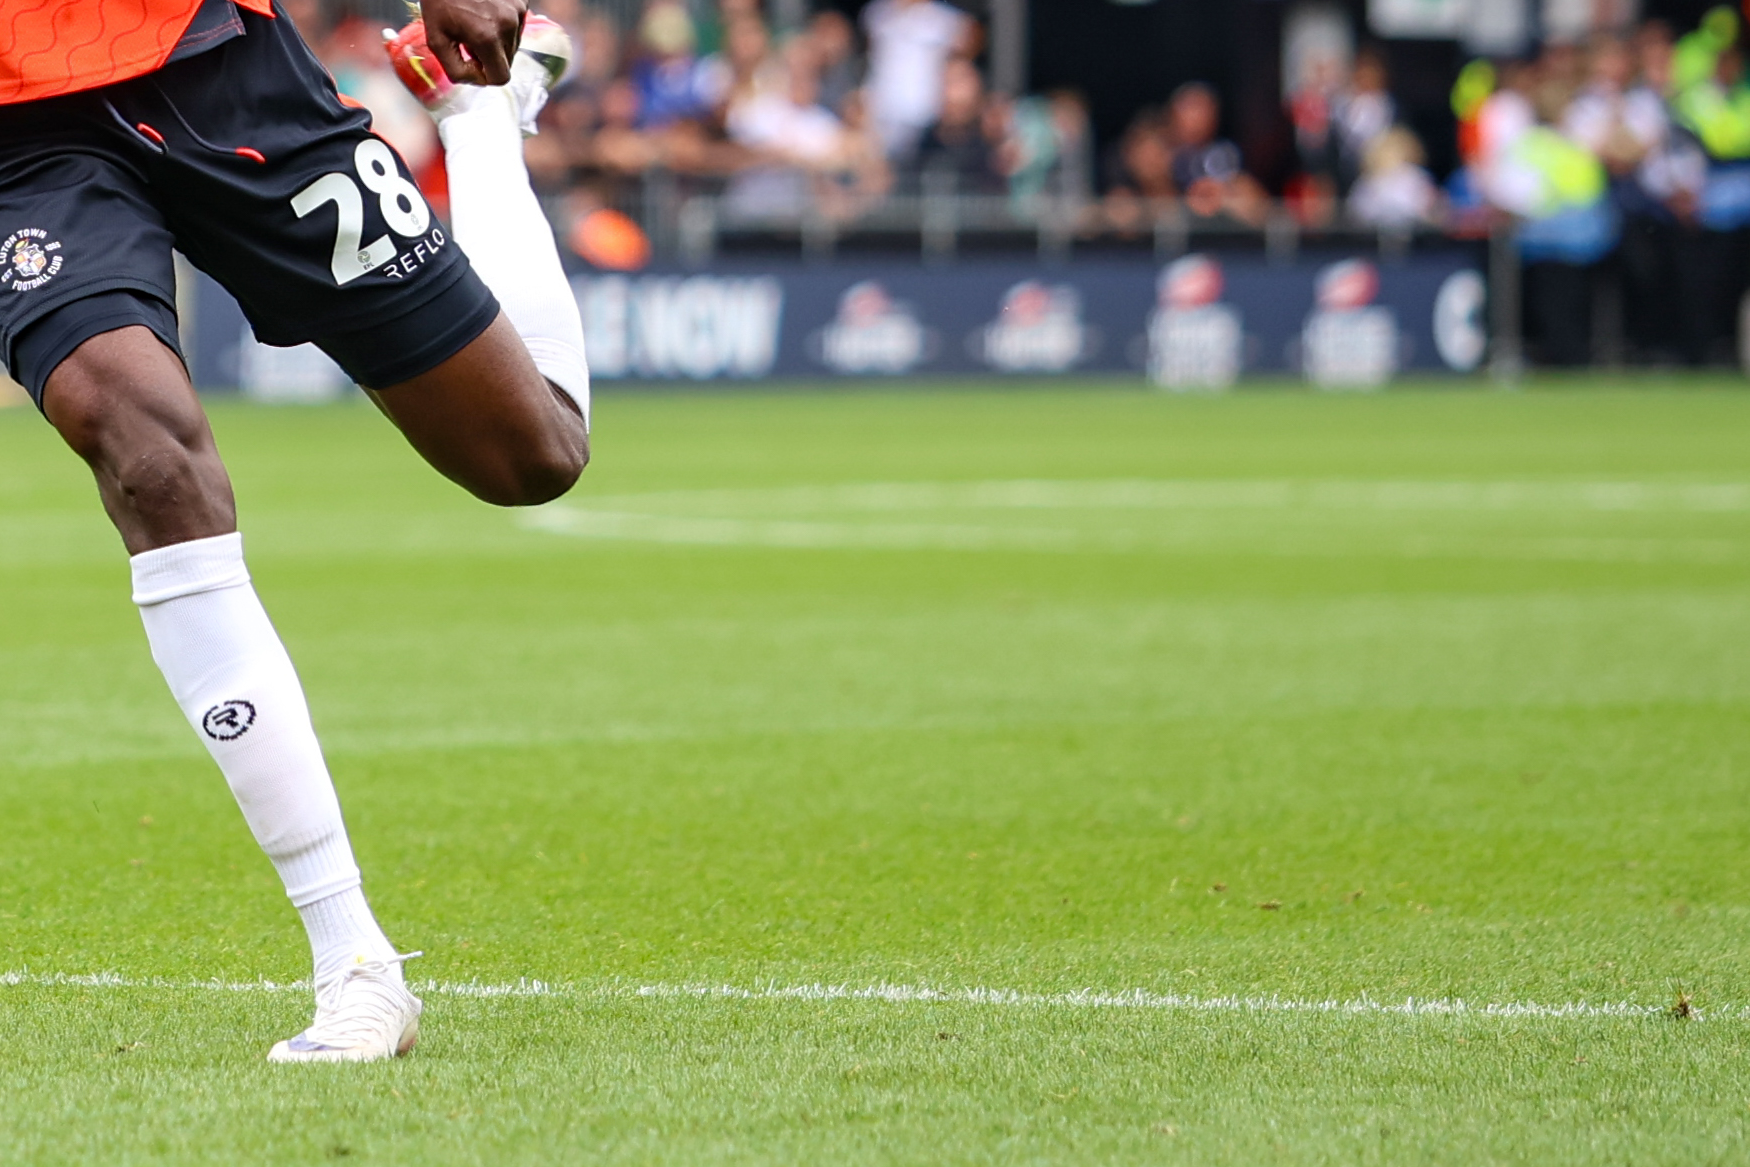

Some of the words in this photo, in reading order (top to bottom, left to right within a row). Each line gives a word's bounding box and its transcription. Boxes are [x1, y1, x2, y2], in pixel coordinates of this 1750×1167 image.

[290, 138, 430, 285] 28
[16, 228, 48, 239] TOWN
[383, 228, 445, 279] REFLO
[12, 273, 52, 291] FOOTBALL
[47, 255, 64, 275] CLUB
